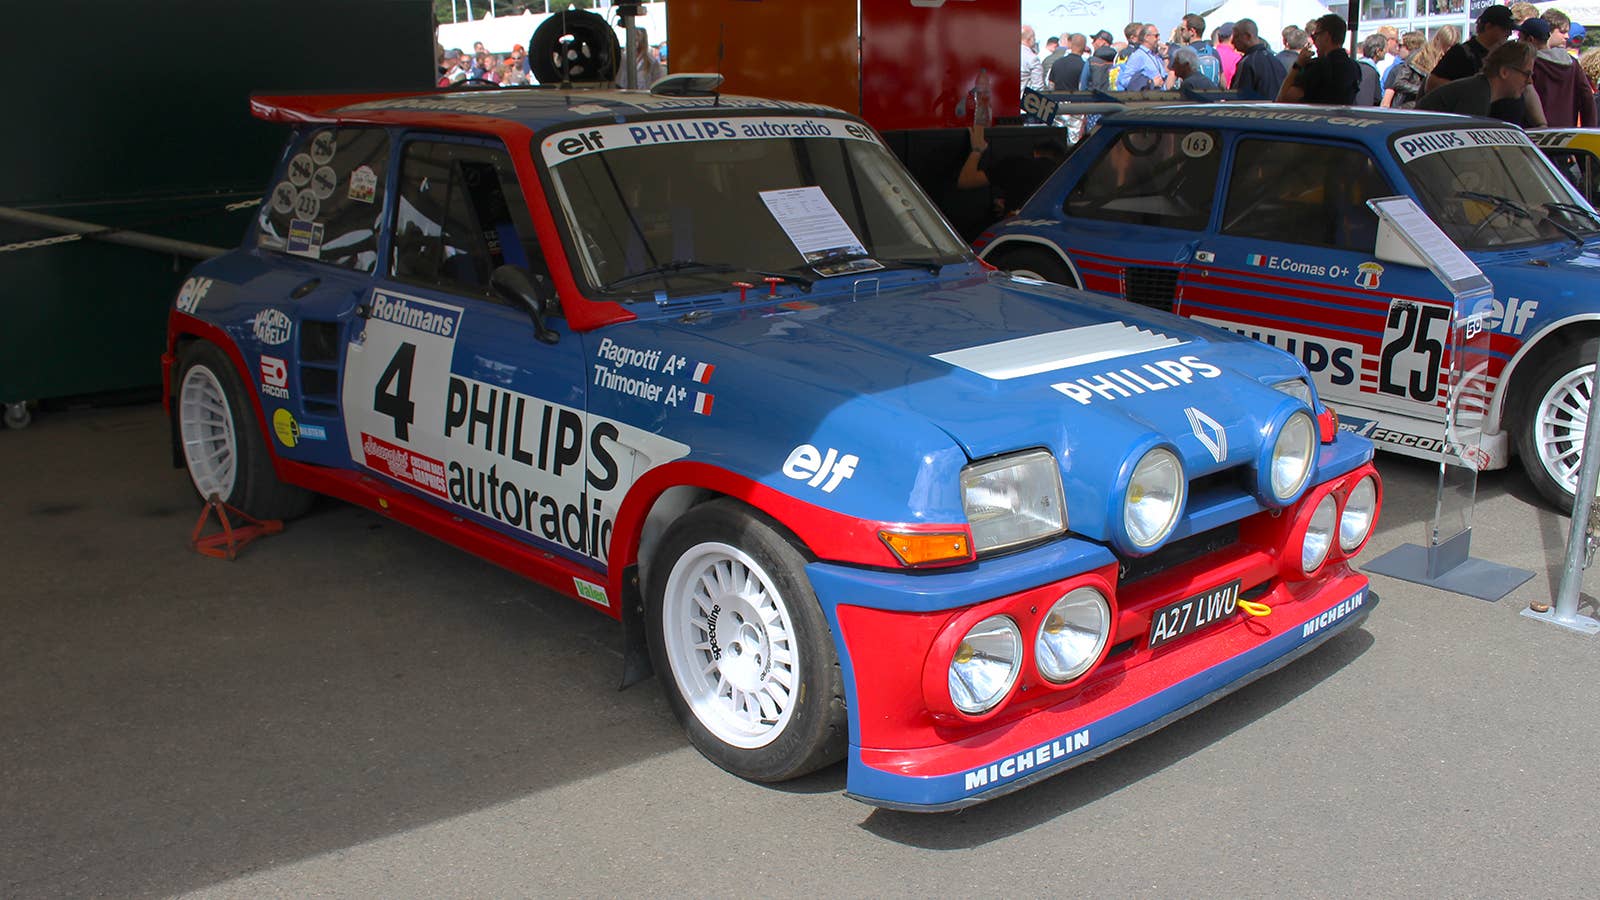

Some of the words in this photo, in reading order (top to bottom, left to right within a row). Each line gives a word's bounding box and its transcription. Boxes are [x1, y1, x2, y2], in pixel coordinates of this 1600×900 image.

[1024, 93, 1056, 121] elf
[1210, 110, 1323, 123] RENAULT
[556, 129, 605, 156] elf
[628, 120, 737, 145] PHILIPS
[741, 119, 832, 139] autoradio
[844, 123, 877, 142] elf
[1185, 136, 1208, 152] 163
[1400, 131, 1465, 157] PHILIPS
[1466, 130, 1526, 146] RENAULT
[1268, 256, 1327, 277] E.Comas
[1328, 265, 1350, 278] O+
[176, 276, 213, 315] elf
[255, 307, 293, 331] MAGNETI
[371, 295, 454, 337] Rothmans
[1467, 319, 1480, 338] 50
[1472, 296, 1539, 335] elf
[597, 337, 662, 368] Ragnotti
[1379, 299, 1450, 402] 25
[373, 341, 417, 442] 4
[593, 363, 663, 402] Thimonier
[1050, 355, 1223, 405] PHILIPS
[444, 377, 620, 492] PHILIPS
[412, 467, 446, 493] GRAPHICS
[782, 443, 860, 493] elf
[575, 579, 608, 605] Valeo
[708, 604, 721, 662] speedline
[1151, 602, 1191, 645] A27
[1195, 583, 1239, 628] LWU
[1302, 592, 1363, 638] MICHELIN
[964, 729, 1090, 791] MICHELIN
